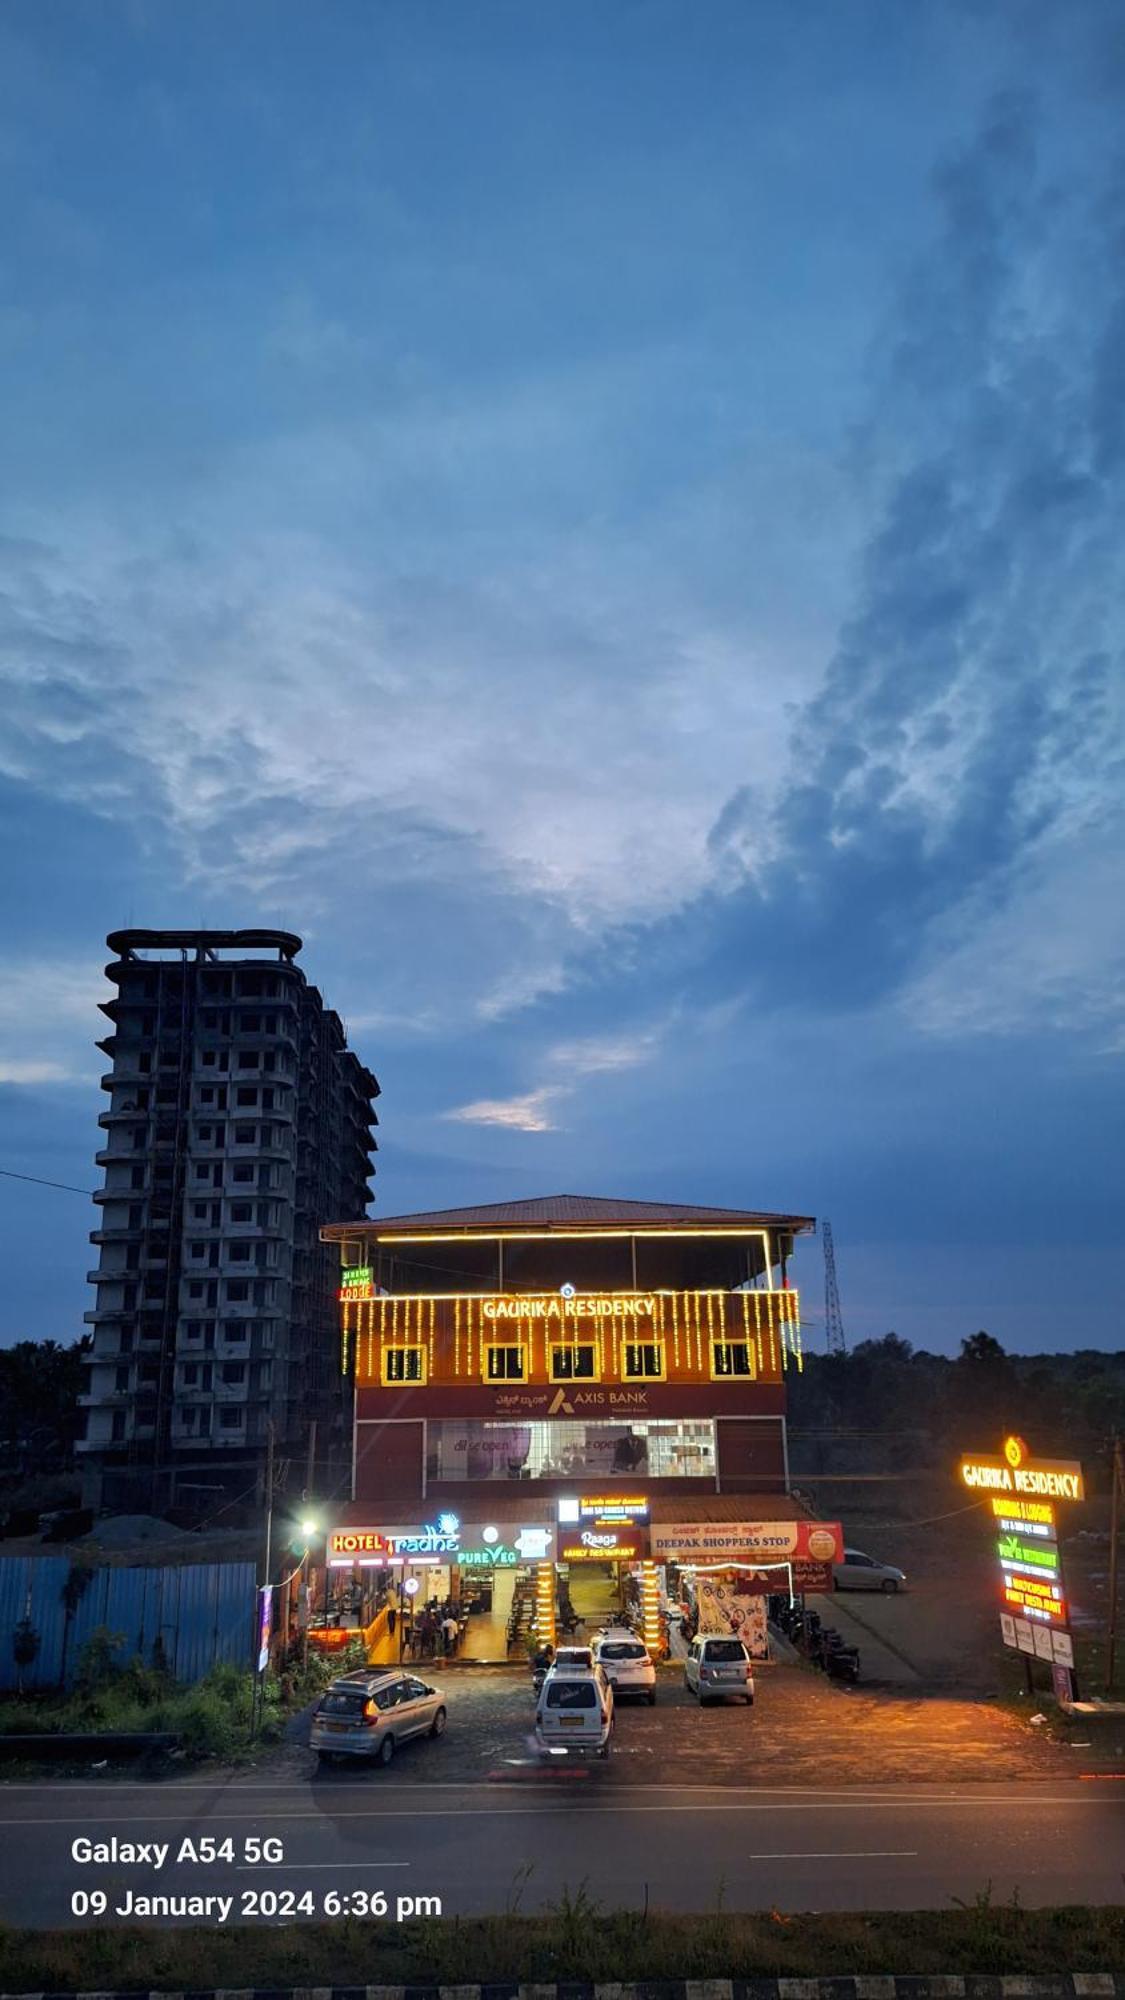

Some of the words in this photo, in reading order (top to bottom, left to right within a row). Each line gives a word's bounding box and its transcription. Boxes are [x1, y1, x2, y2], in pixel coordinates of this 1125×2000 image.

[483, 1301, 560, 1318] GAURIKA
[565, 1300, 655, 1317] RESIDENCY
[574, 1392, 605, 1404] AXIS
[609, 1392, 648, 1404] BANK
[962, 1464, 1013, 1490] GAURIKA
[1013, 1469, 1079, 1498] RESIDENCY
[333, 1535, 383, 1551] HOTEL
[656, 1537, 701, 1548] DEEPAK
[703, 1537, 760, 1547] SHOPPERS
[763, 1536, 791, 1546] STOP
[457, 1552, 489, 1564] PURE
